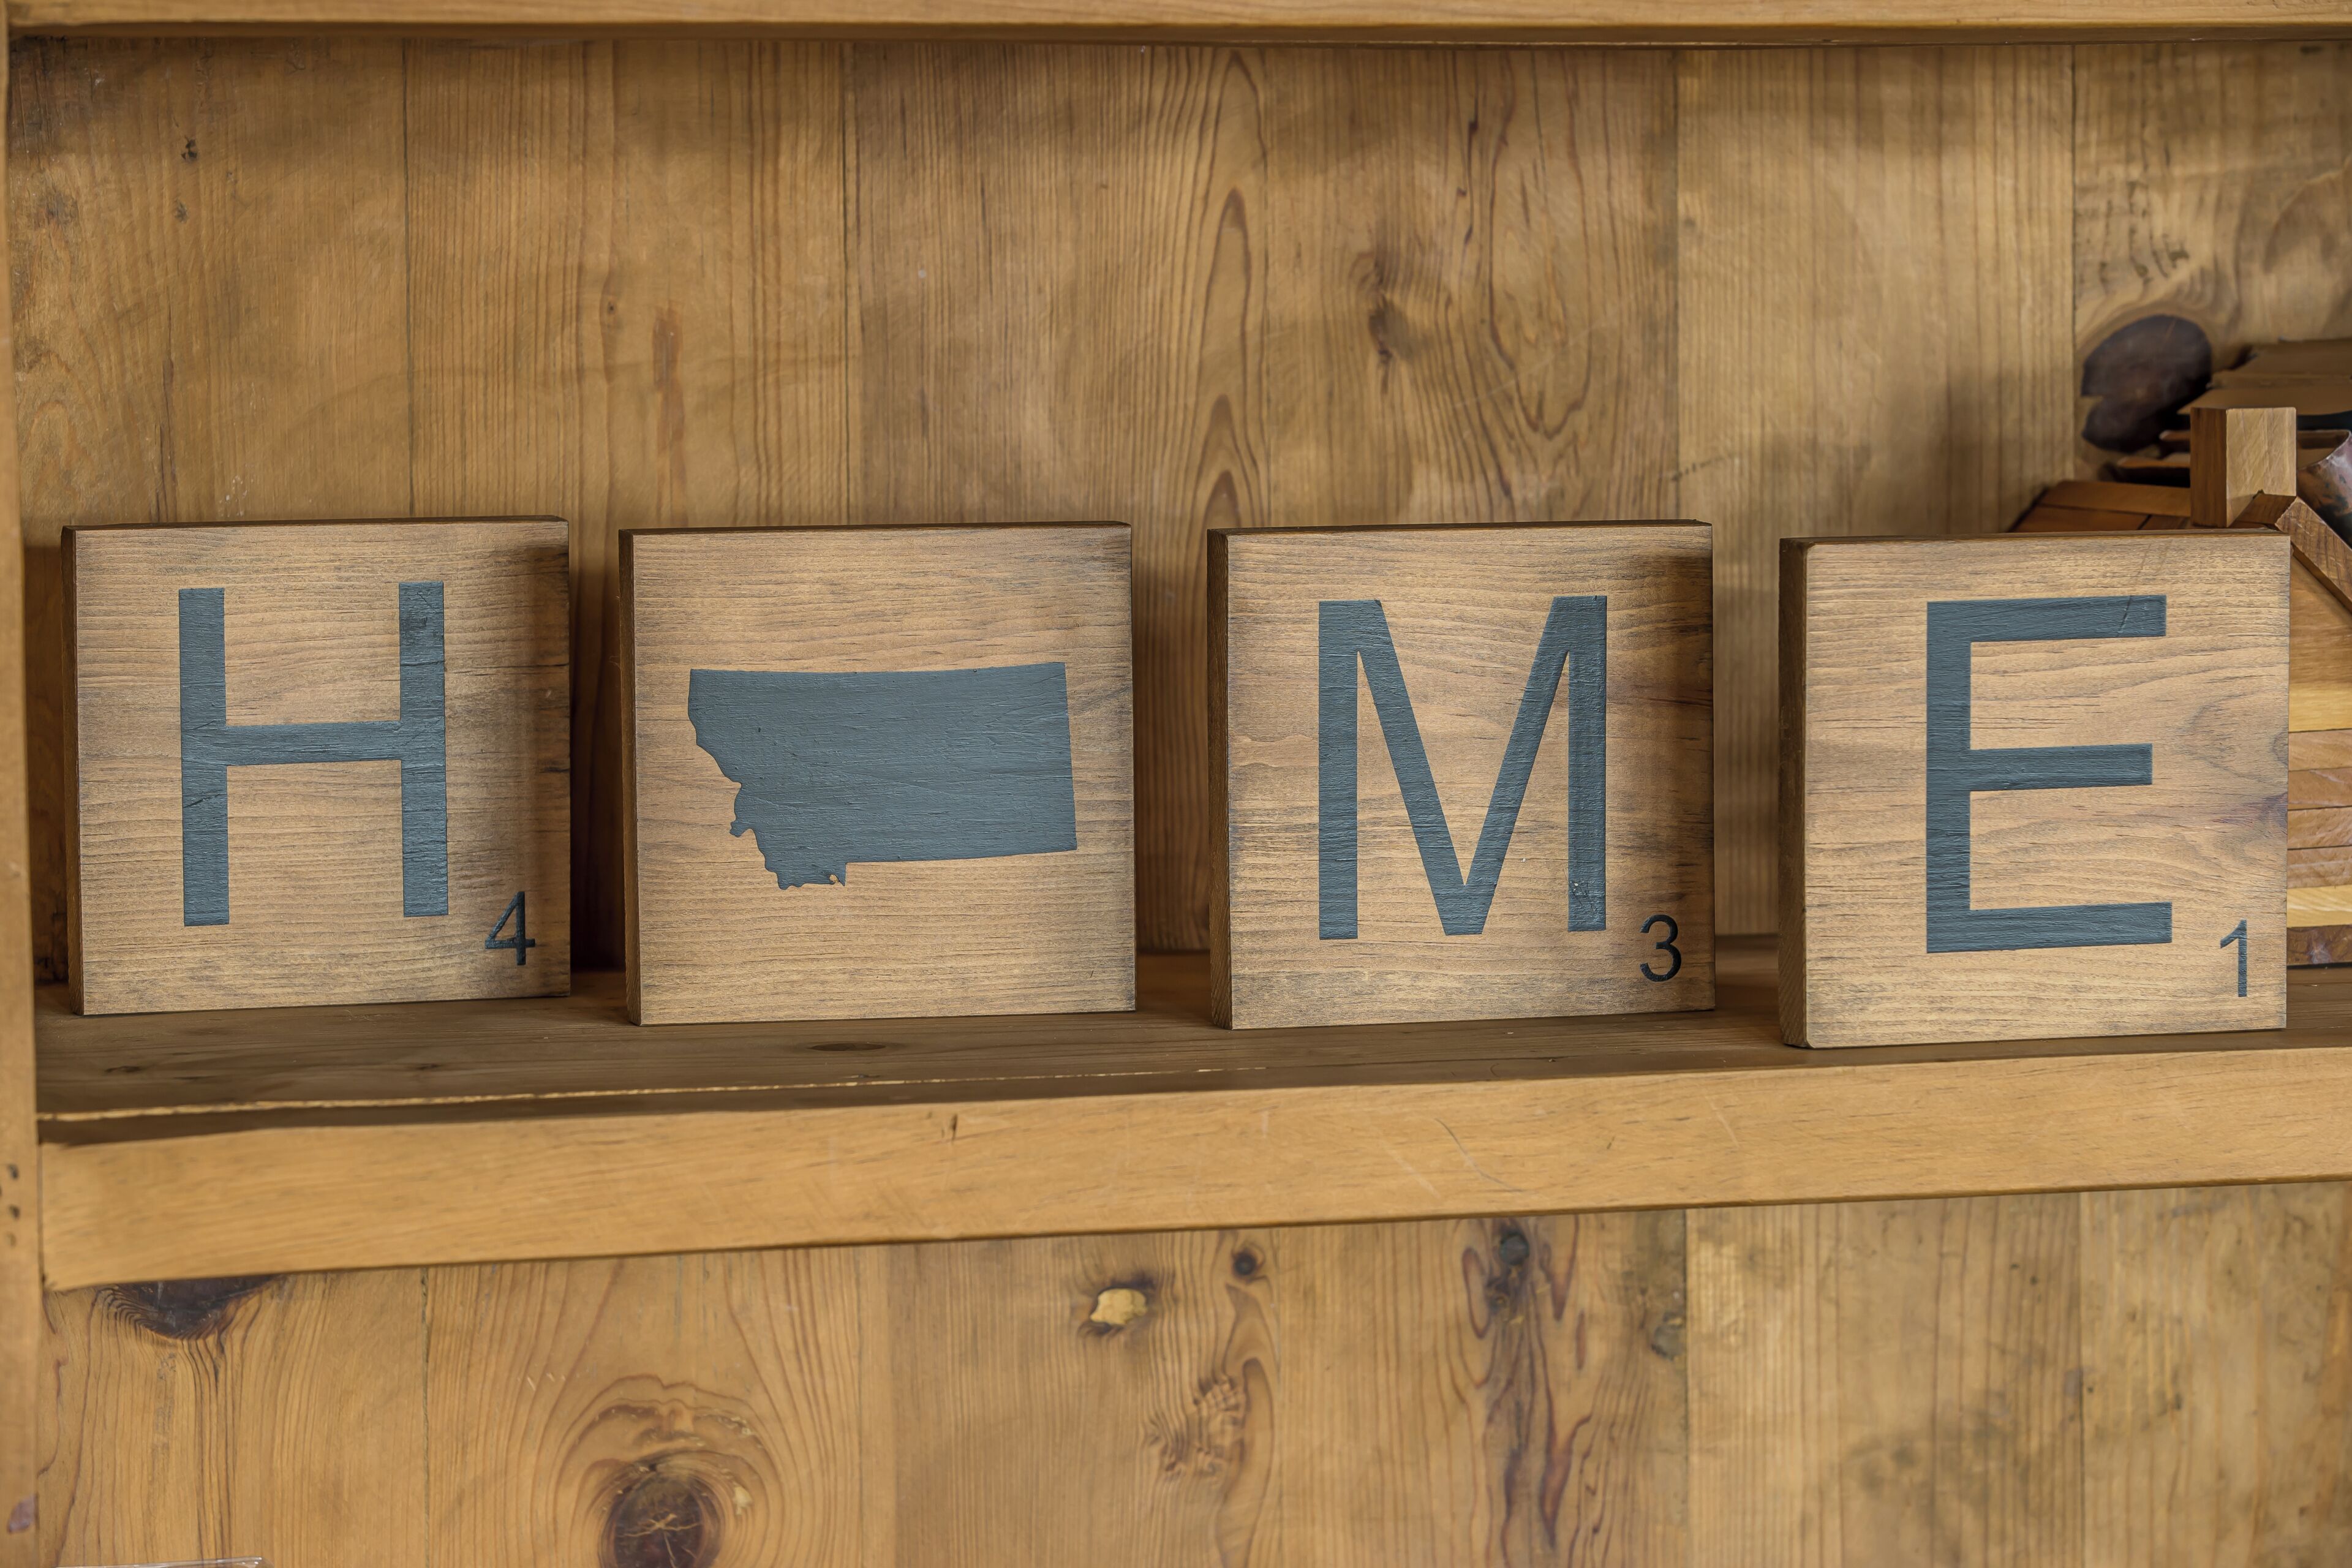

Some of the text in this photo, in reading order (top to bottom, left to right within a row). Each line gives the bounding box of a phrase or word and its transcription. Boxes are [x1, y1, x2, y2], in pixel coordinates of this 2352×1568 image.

[179, 581, 448, 926] H
[1318, 595, 1607, 940] M
[1926, 595, 2172, 953] E
[485, 891, 535, 965] 4
[1640, 914, 1681, 982] 3
[2220, 919, 2247, 997] 1
